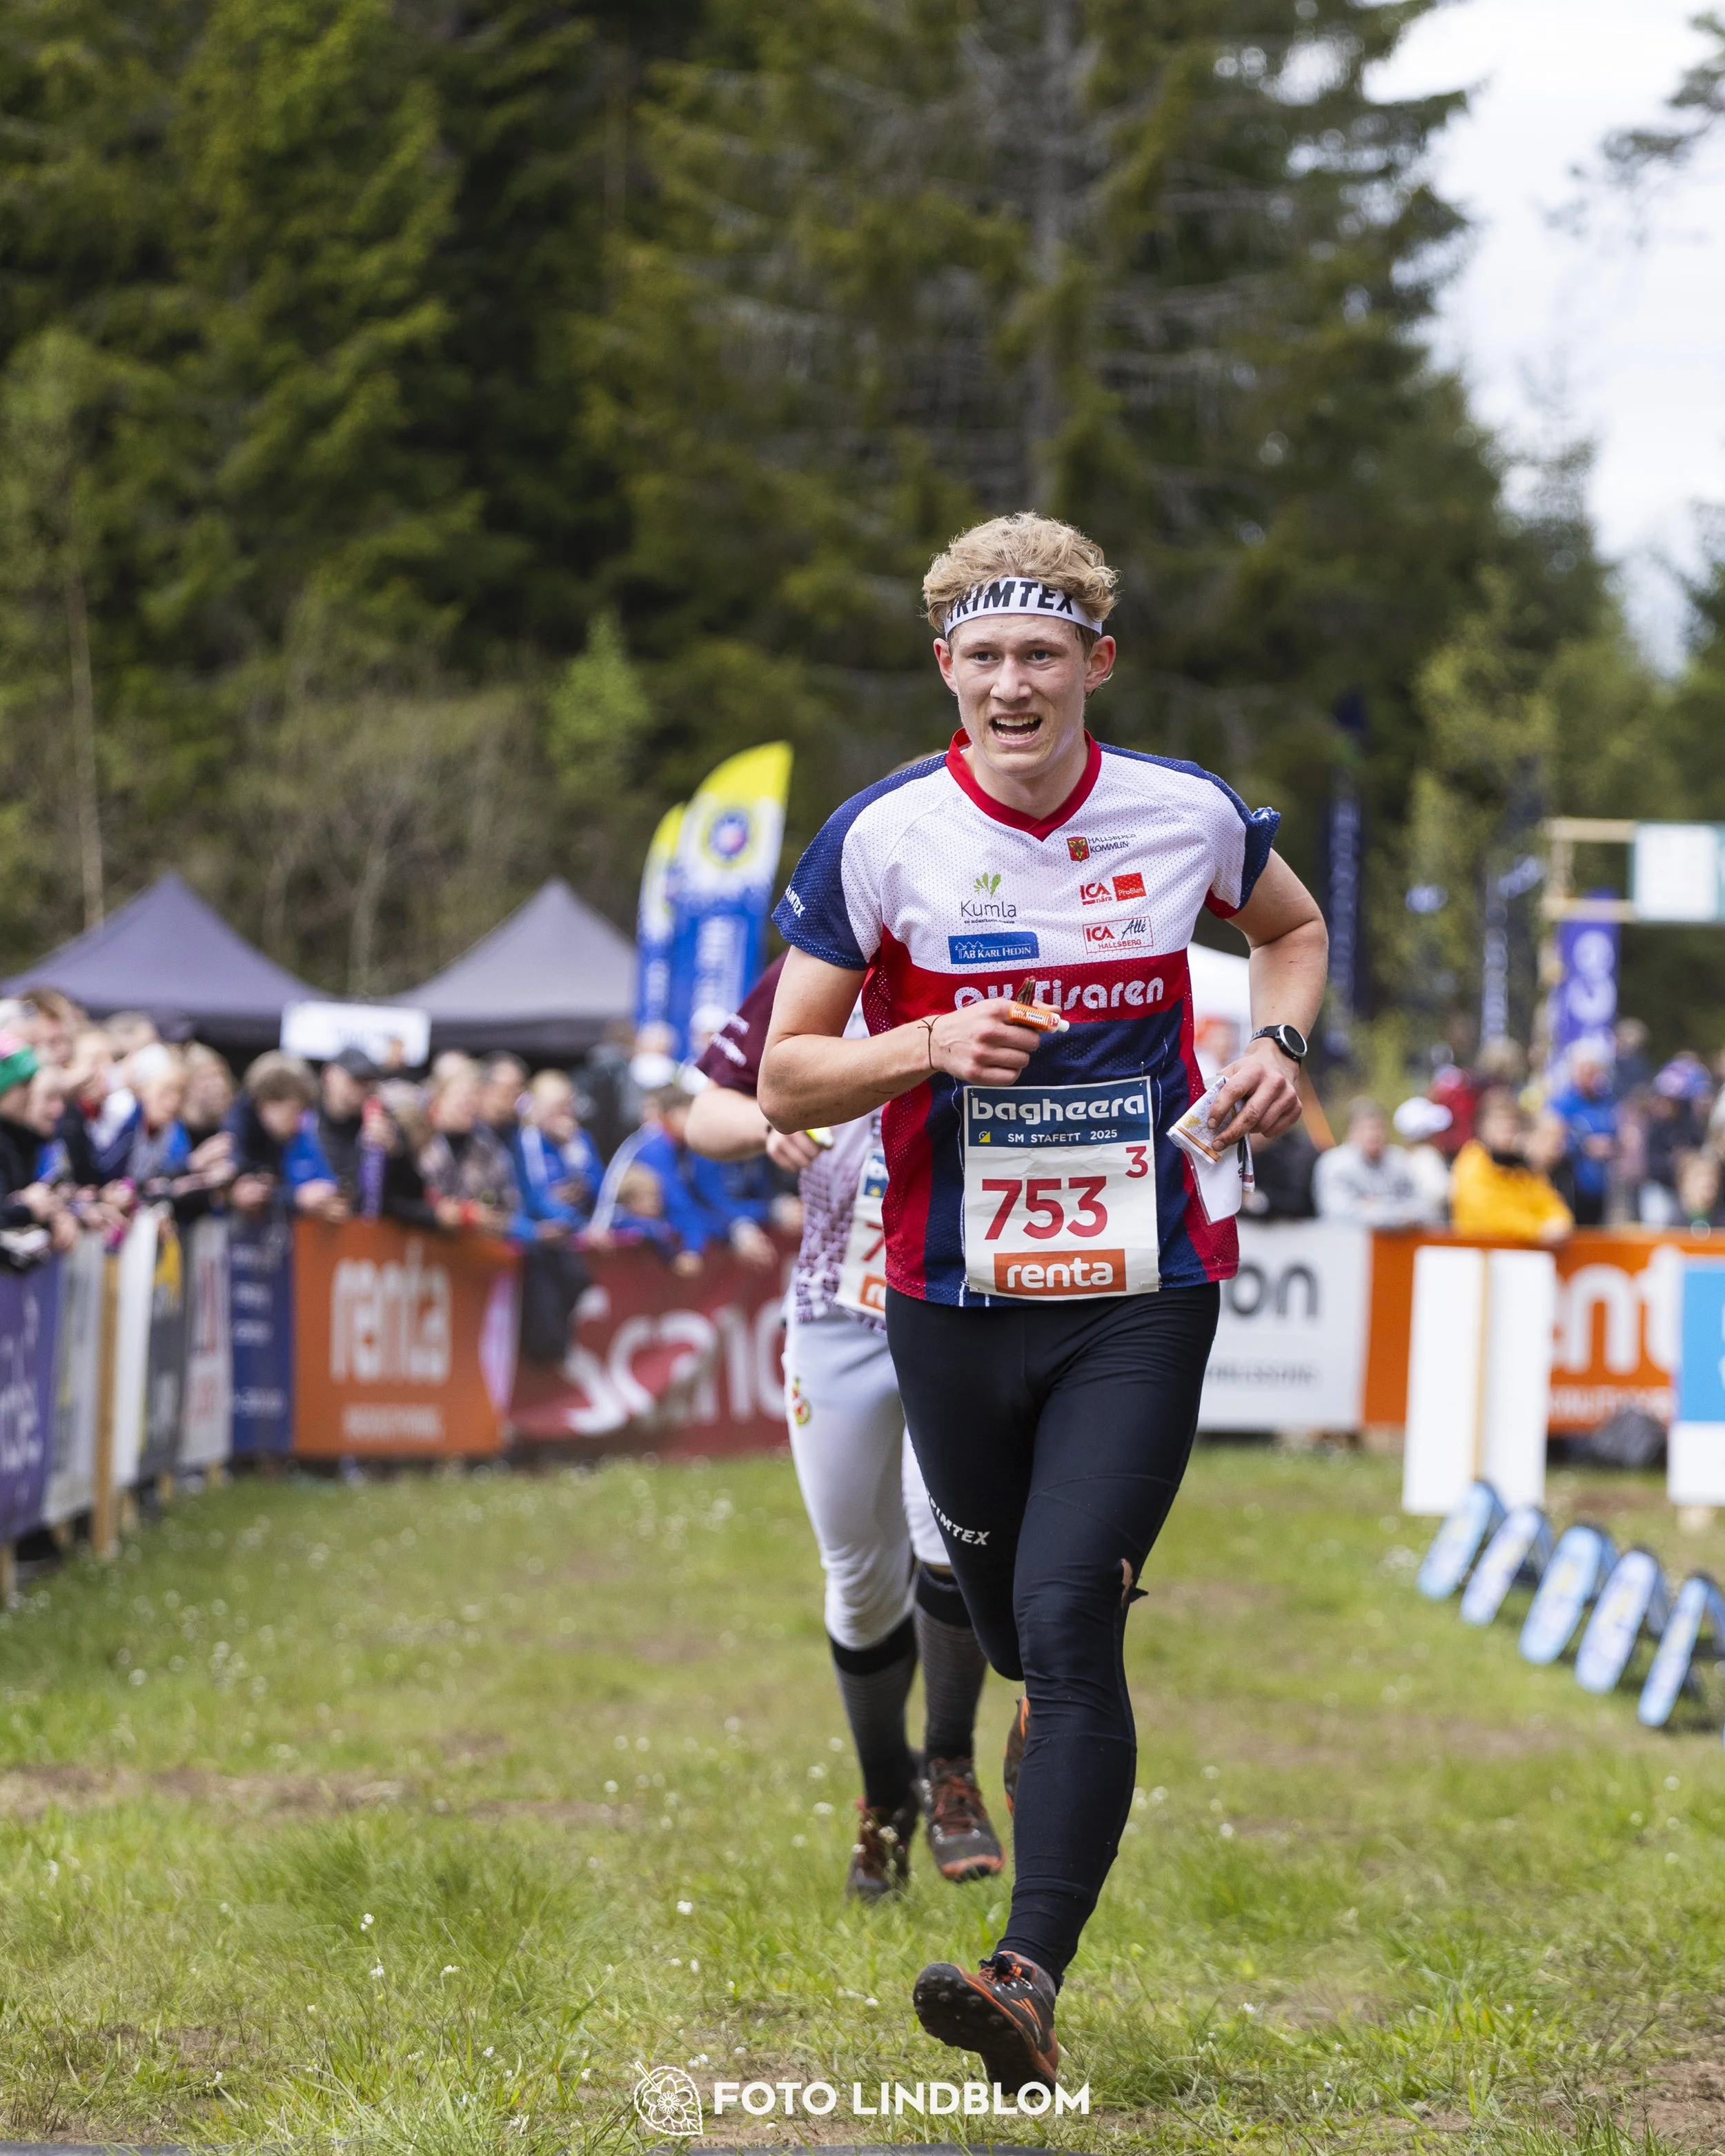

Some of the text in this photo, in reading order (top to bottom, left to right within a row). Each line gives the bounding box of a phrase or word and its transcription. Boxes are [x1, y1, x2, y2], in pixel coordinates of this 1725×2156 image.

[1090, 841, 1130, 853] KOMMUN
[1080, 882, 1111, 900] ICA
[1118, 887, 1143, 896] Profilen
[961, 899, 1016, 918] Kumla
[1086, 926, 1115, 942] ICA
[1098, 939, 1141, 949] HALLSBERG
[972, 1094, 1145, 1125] bagheera
[1007, 1129, 1118, 1143] SM STAFETT 2025
[1125, 1146, 1149, 1178] 3
[981, 1176, 1108, 1240] 753
[1006, 1257, 1114, 1289] renta
